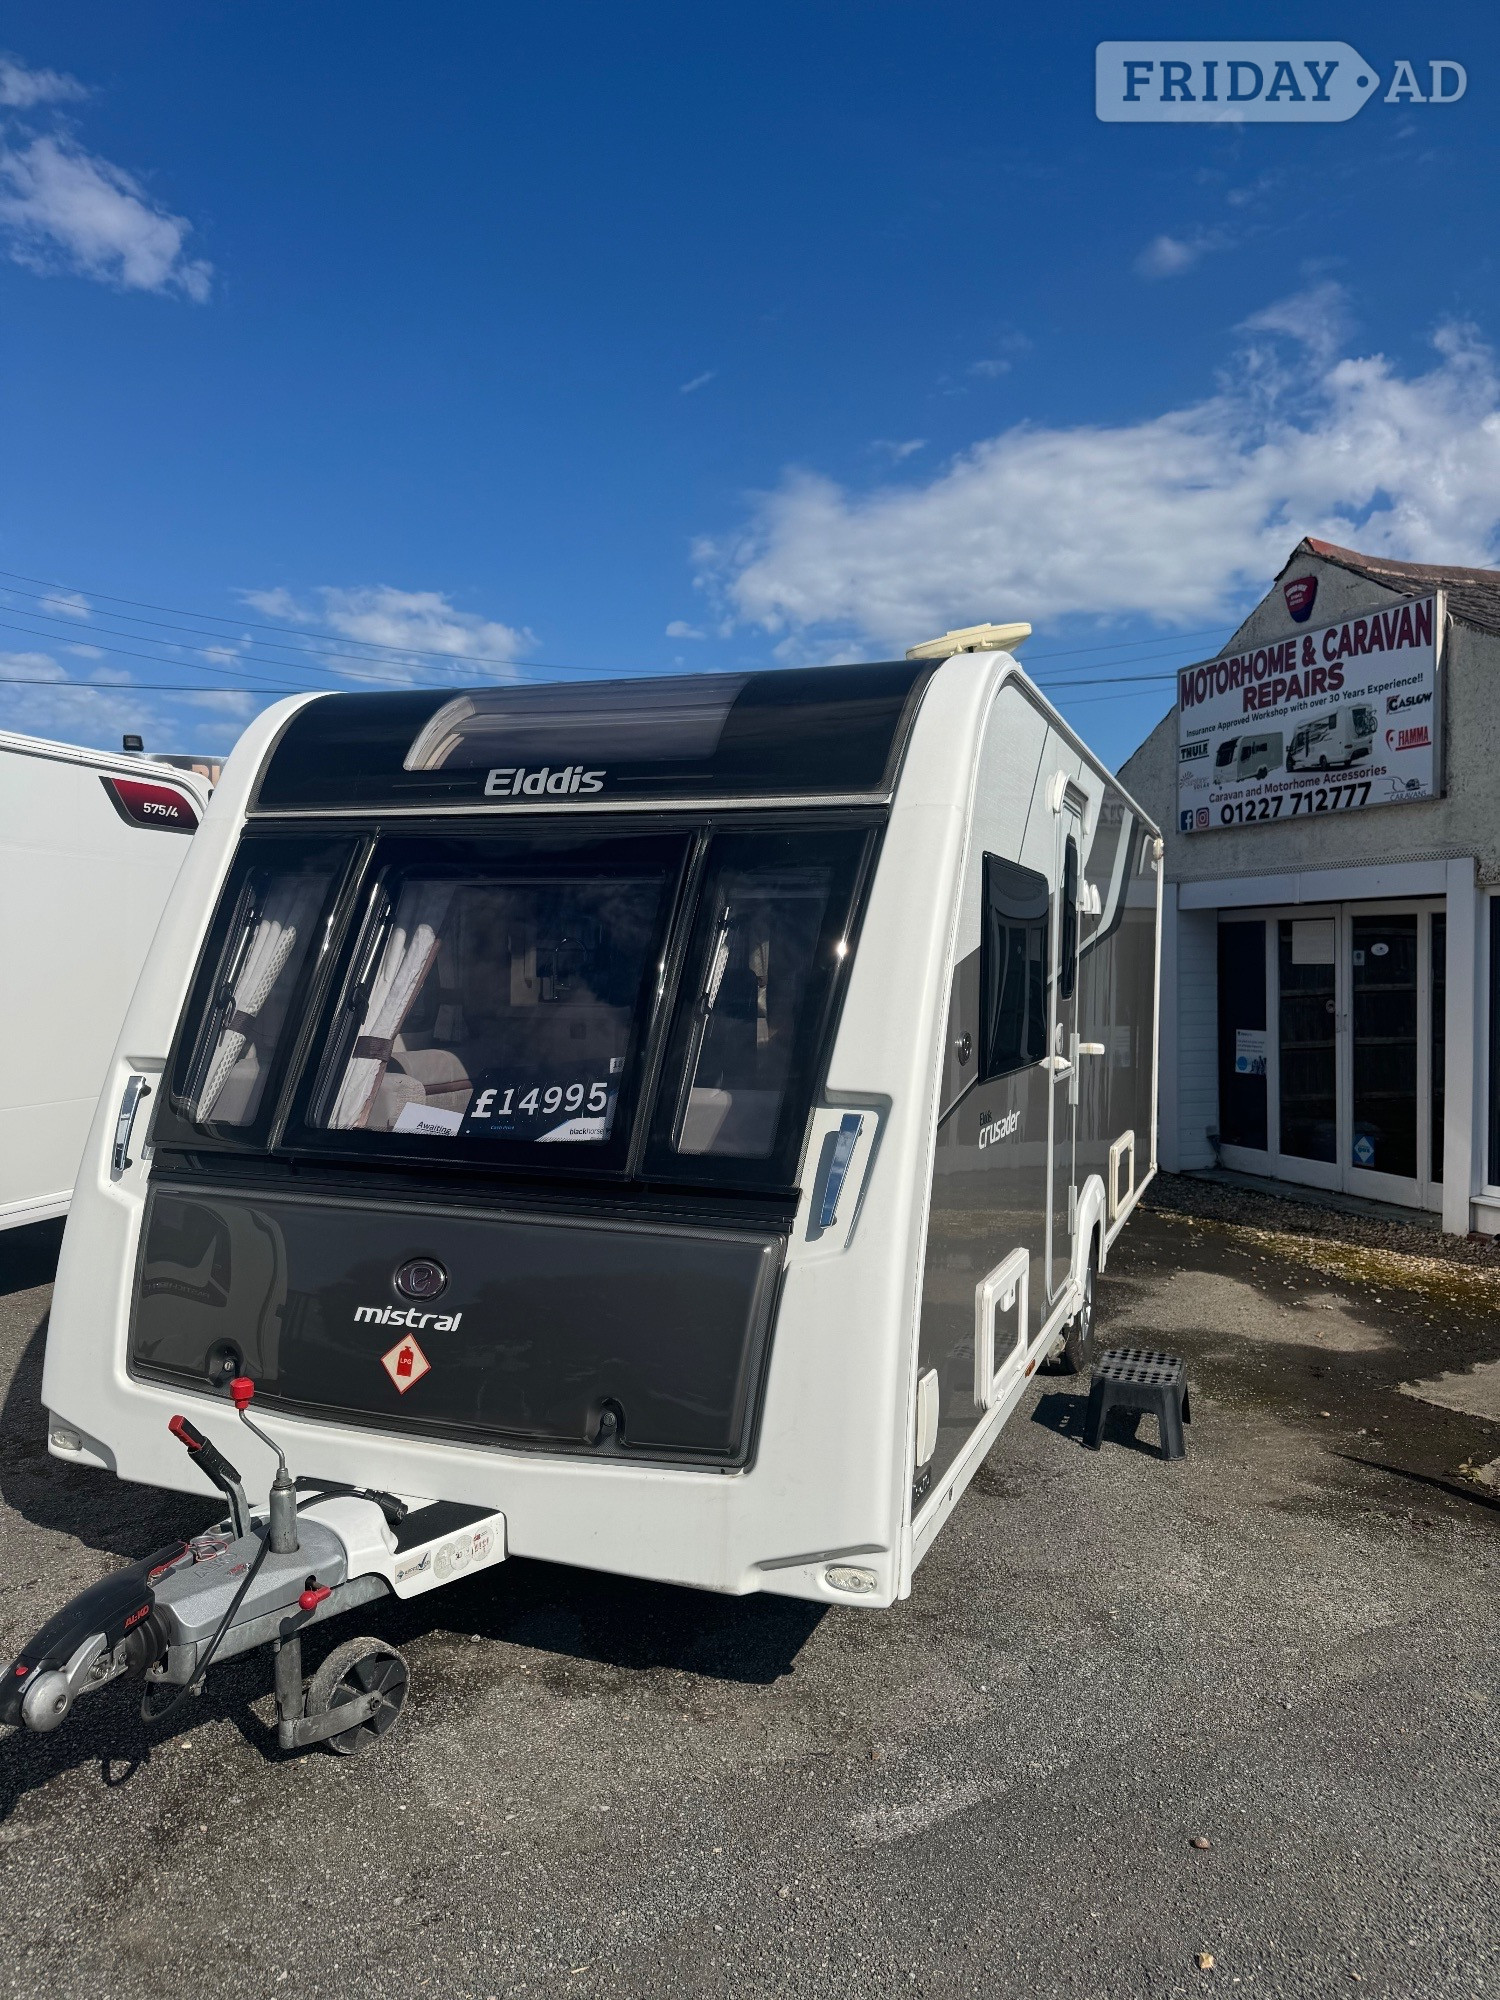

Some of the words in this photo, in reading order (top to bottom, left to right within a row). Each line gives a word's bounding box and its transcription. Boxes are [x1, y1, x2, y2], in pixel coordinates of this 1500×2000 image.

[1181, 640, 1297, 712] MOTORHOME
[1302, 635, 1317, 667] &
[1322, 599, 1432, 662] CARAVAN
[1243, 662, 1345, 713] REPAIRS
[1388, 692, 1433, 711] GASLOW
[1186, 725, 1216, 738] Insurance
[1217, 714, 1250, 731] Approved
[1251, 706, 1289, 722] Workshop
[1290, 701, 1308, 713] with
[1310, 696, 1327, 709] over
[1329, 693, 1340, 703] 30
[1342, 687, 1365, 700] Years
[1367, 673, 1424, 695] Experience!!
[1181, 743, 1208, 760] THULE
[1398, 726, 1429, 747] FIAMMA
[484, 766, 606, 796] Elddis
[1209, 791, 1244, 803] Caravan
[1246, 786, 1262, 798] and
[1264, 776, 1320, 795] Motorhome
[1323, 765, 1387, 785] Accessories
[143, 802, 179, 818] 575/4
[1220, 796, 1284, 825] 01227
[1290, 781, 1372, 816] 712777
[471, 1082, 608, 1118] £14995
[416, 1121, 452, 1135] Awaiting
[979, 1109, 1020, 1149] crusader
[354, 1305, 463, 1332] mistral
